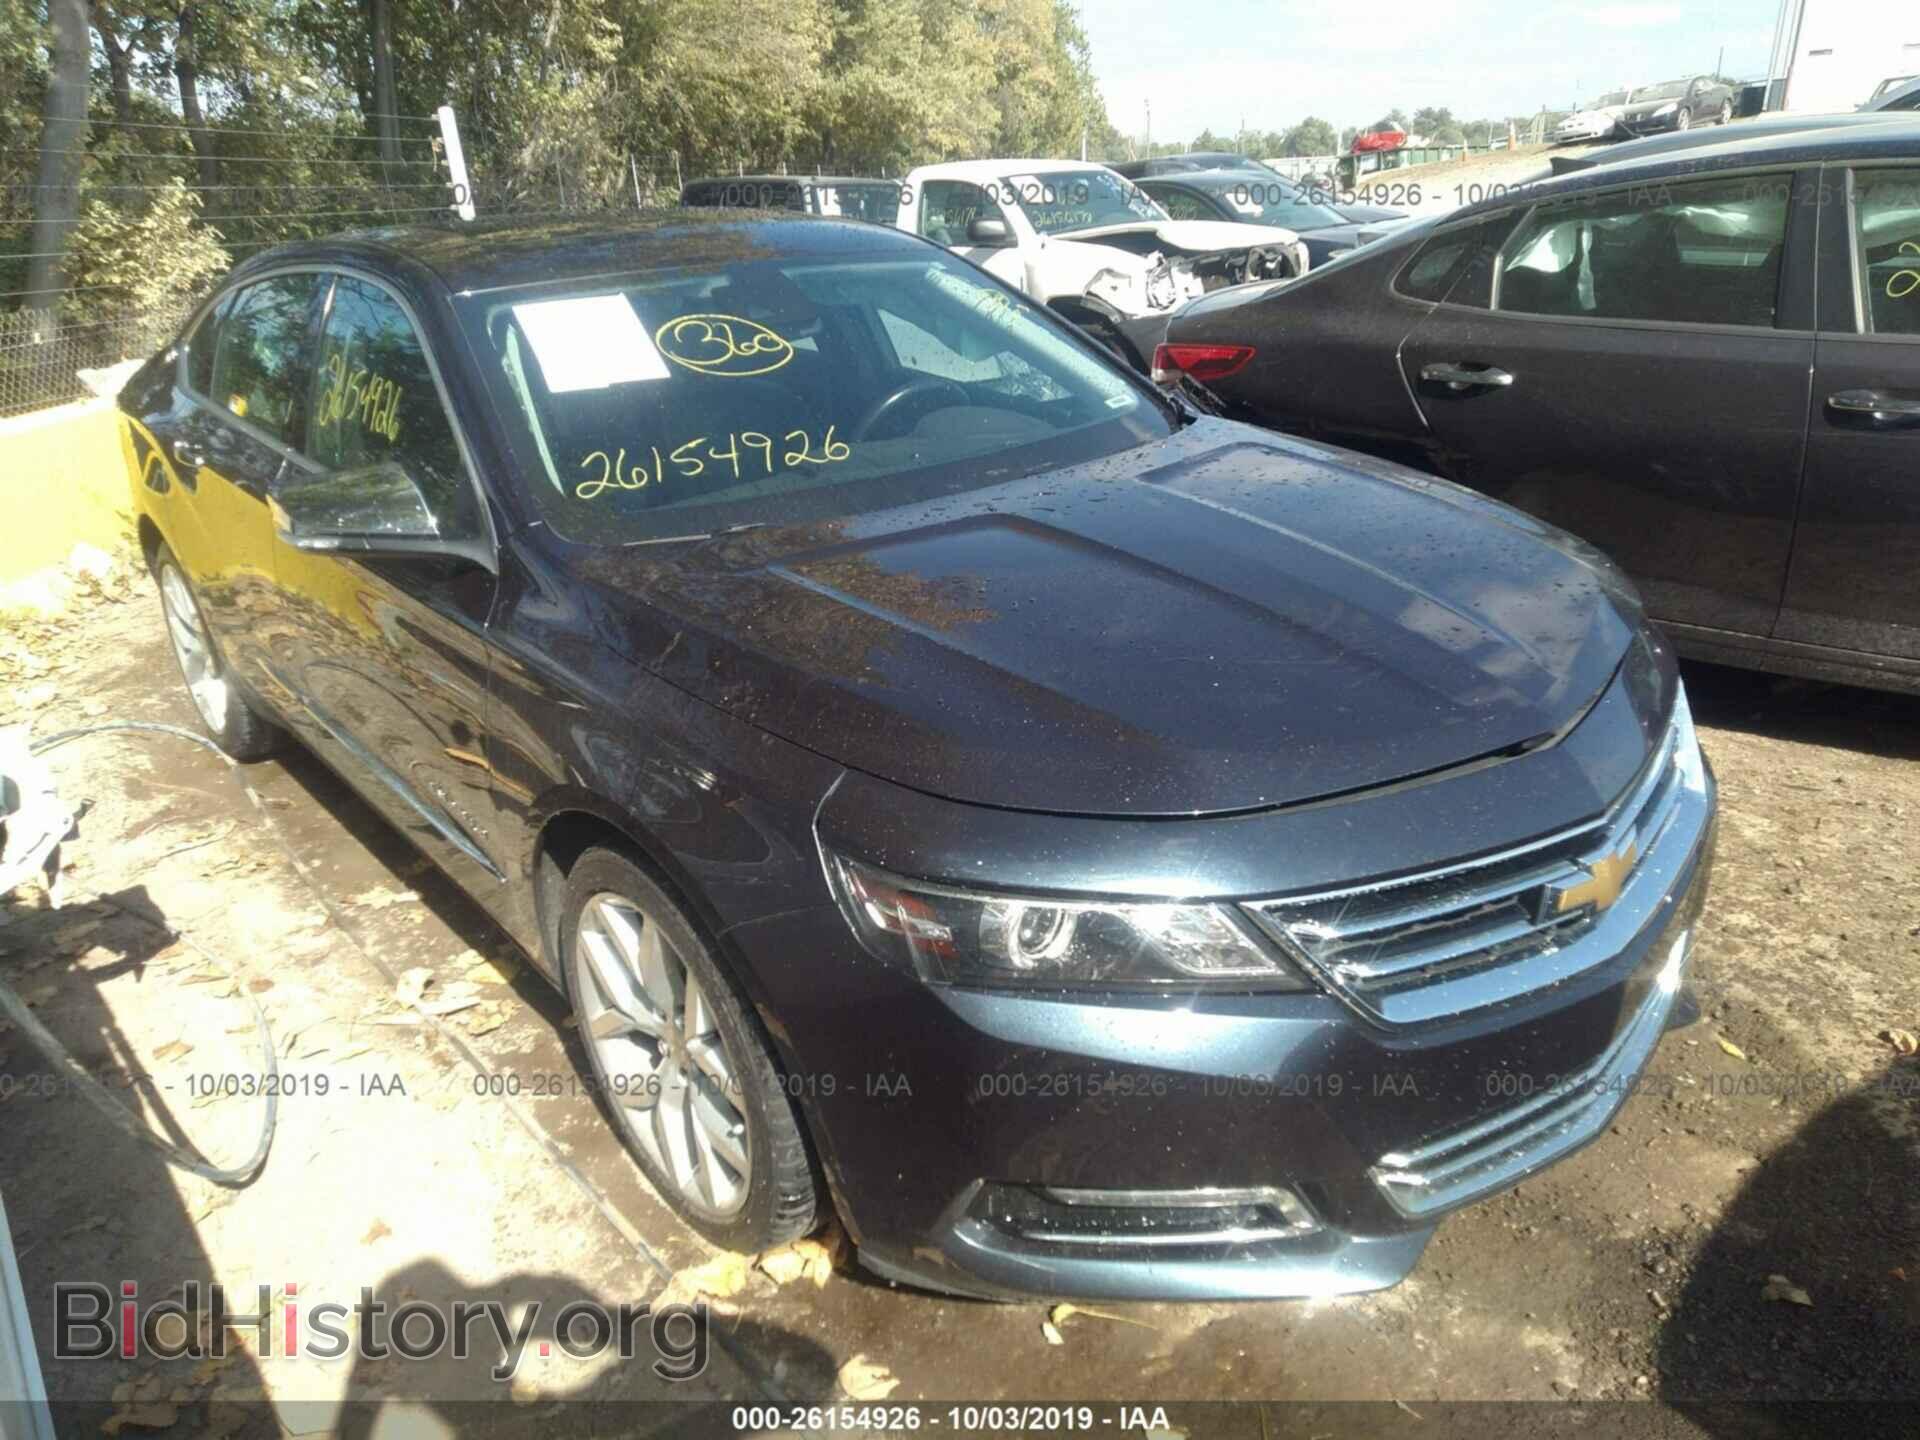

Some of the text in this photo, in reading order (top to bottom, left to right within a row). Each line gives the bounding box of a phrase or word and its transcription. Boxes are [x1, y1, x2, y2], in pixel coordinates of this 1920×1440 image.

[674, 320, 784, 365] 360
[319, 353, 403, 441] 26154926
[576, 426, 850, 498] 26154926
